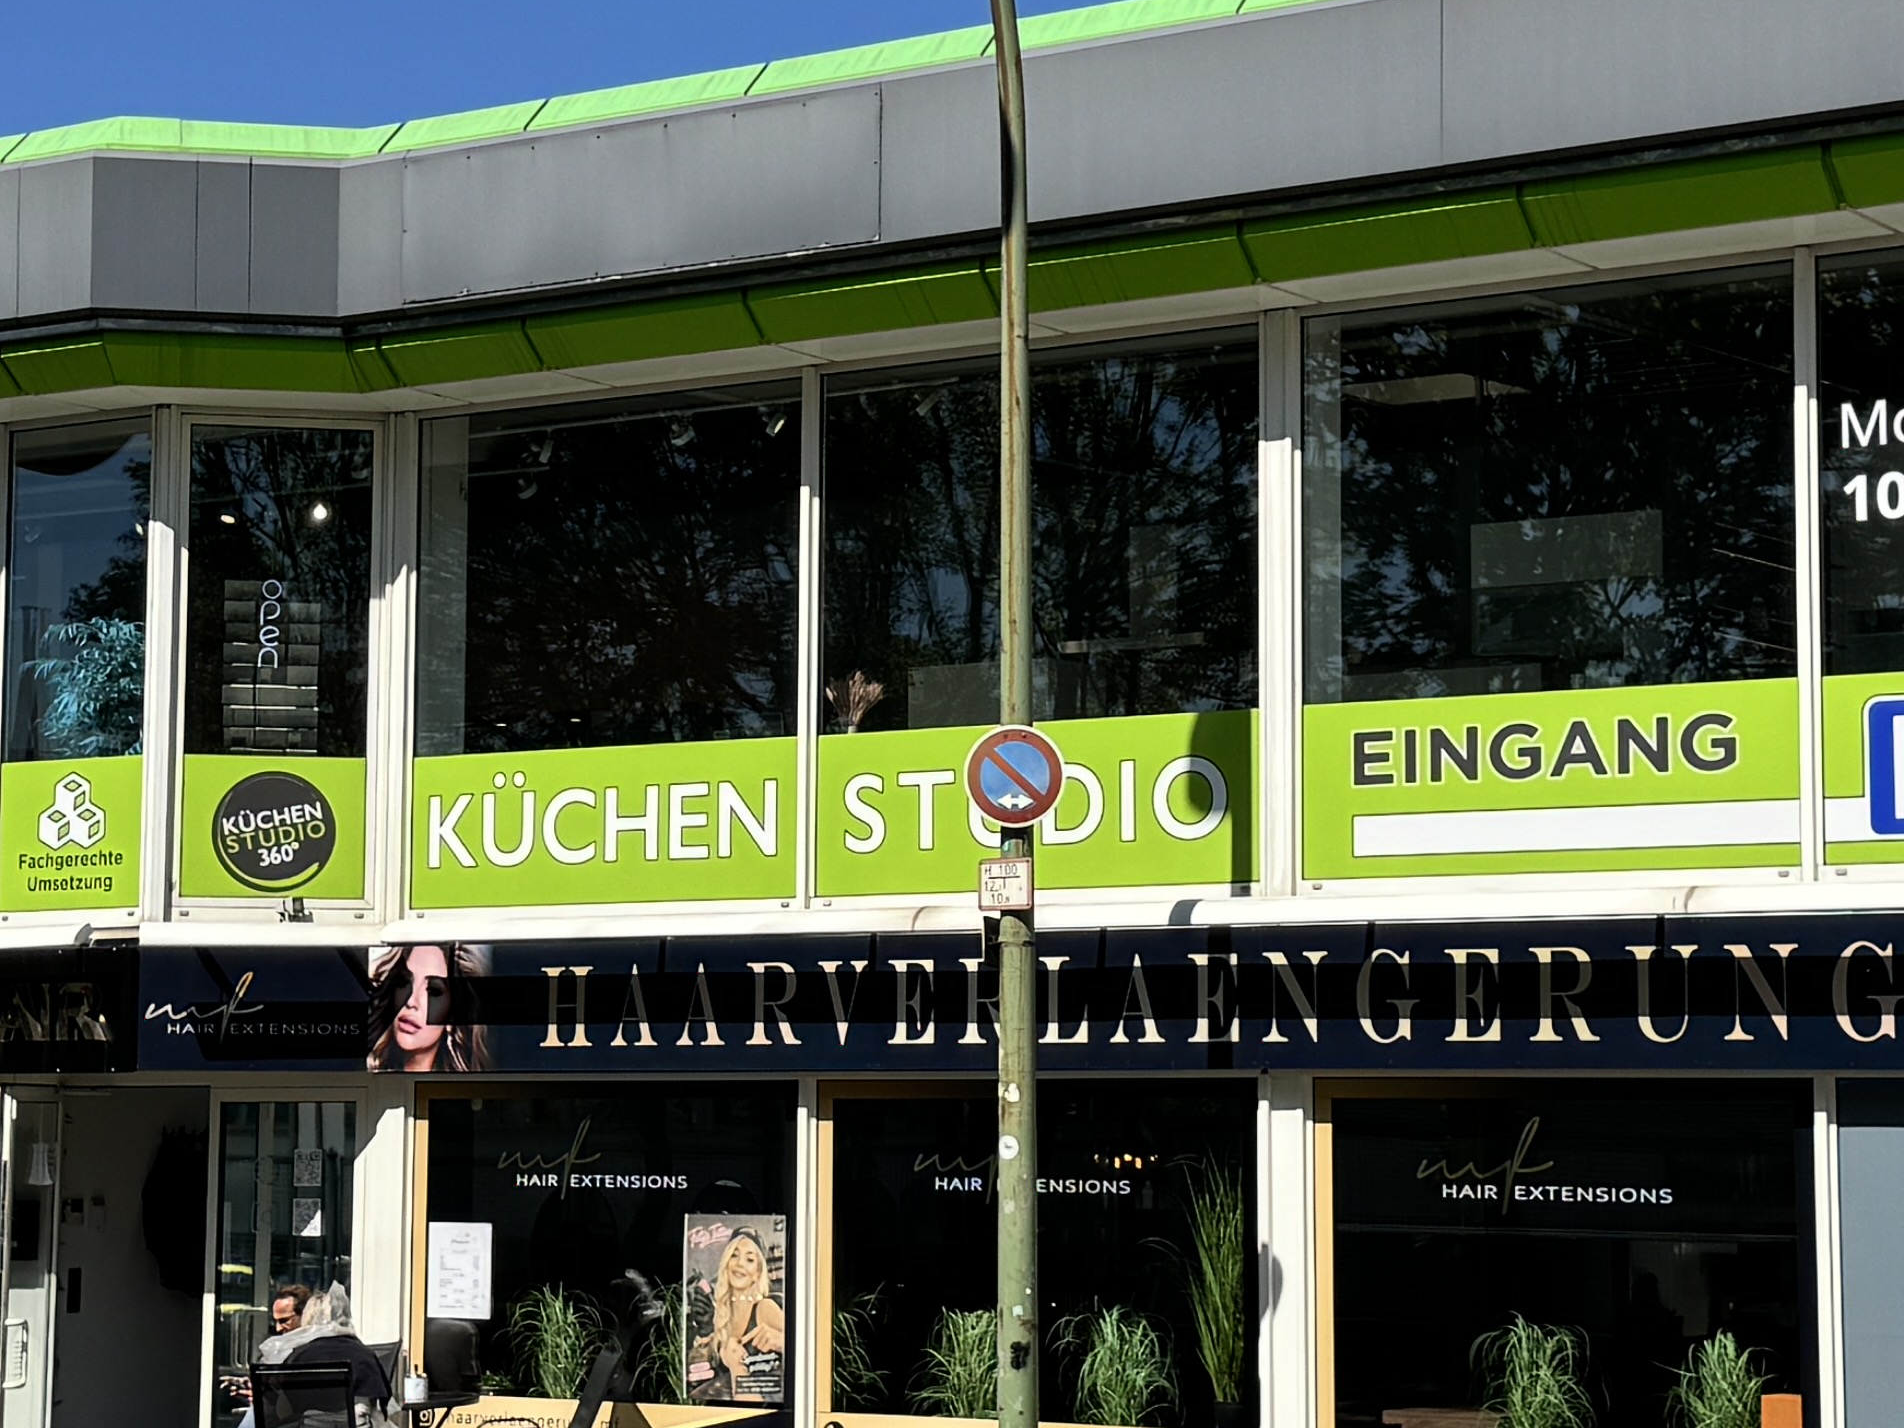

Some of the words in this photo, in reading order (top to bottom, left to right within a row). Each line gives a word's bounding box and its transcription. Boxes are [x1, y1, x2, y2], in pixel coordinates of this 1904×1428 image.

[1352, 712, 1739, 787] EINGANG
[221, 800, 323, 835] KÜCHEN
[426, 771, 779, 869] KÜCHEN
[224, 817, 326, 855] STUDIO
[18, 849, 123, 872] Fachgerechte
[27, 872, 113, 895] Umsetzung
[167, 1022, 214, 1035] HAIR
[230, 1022, 361, 1036] EXTENSIONS
[516, 1174, 559, 1187] HAIR
[570, 1174, 689, 1190] EXTENSIONS
[934, 1176, 983, 1192] HAIR
[1442, 1184, 1498, 1200] HAIR
[1513, 1185, 1674, 1204] EXTENSIONS
